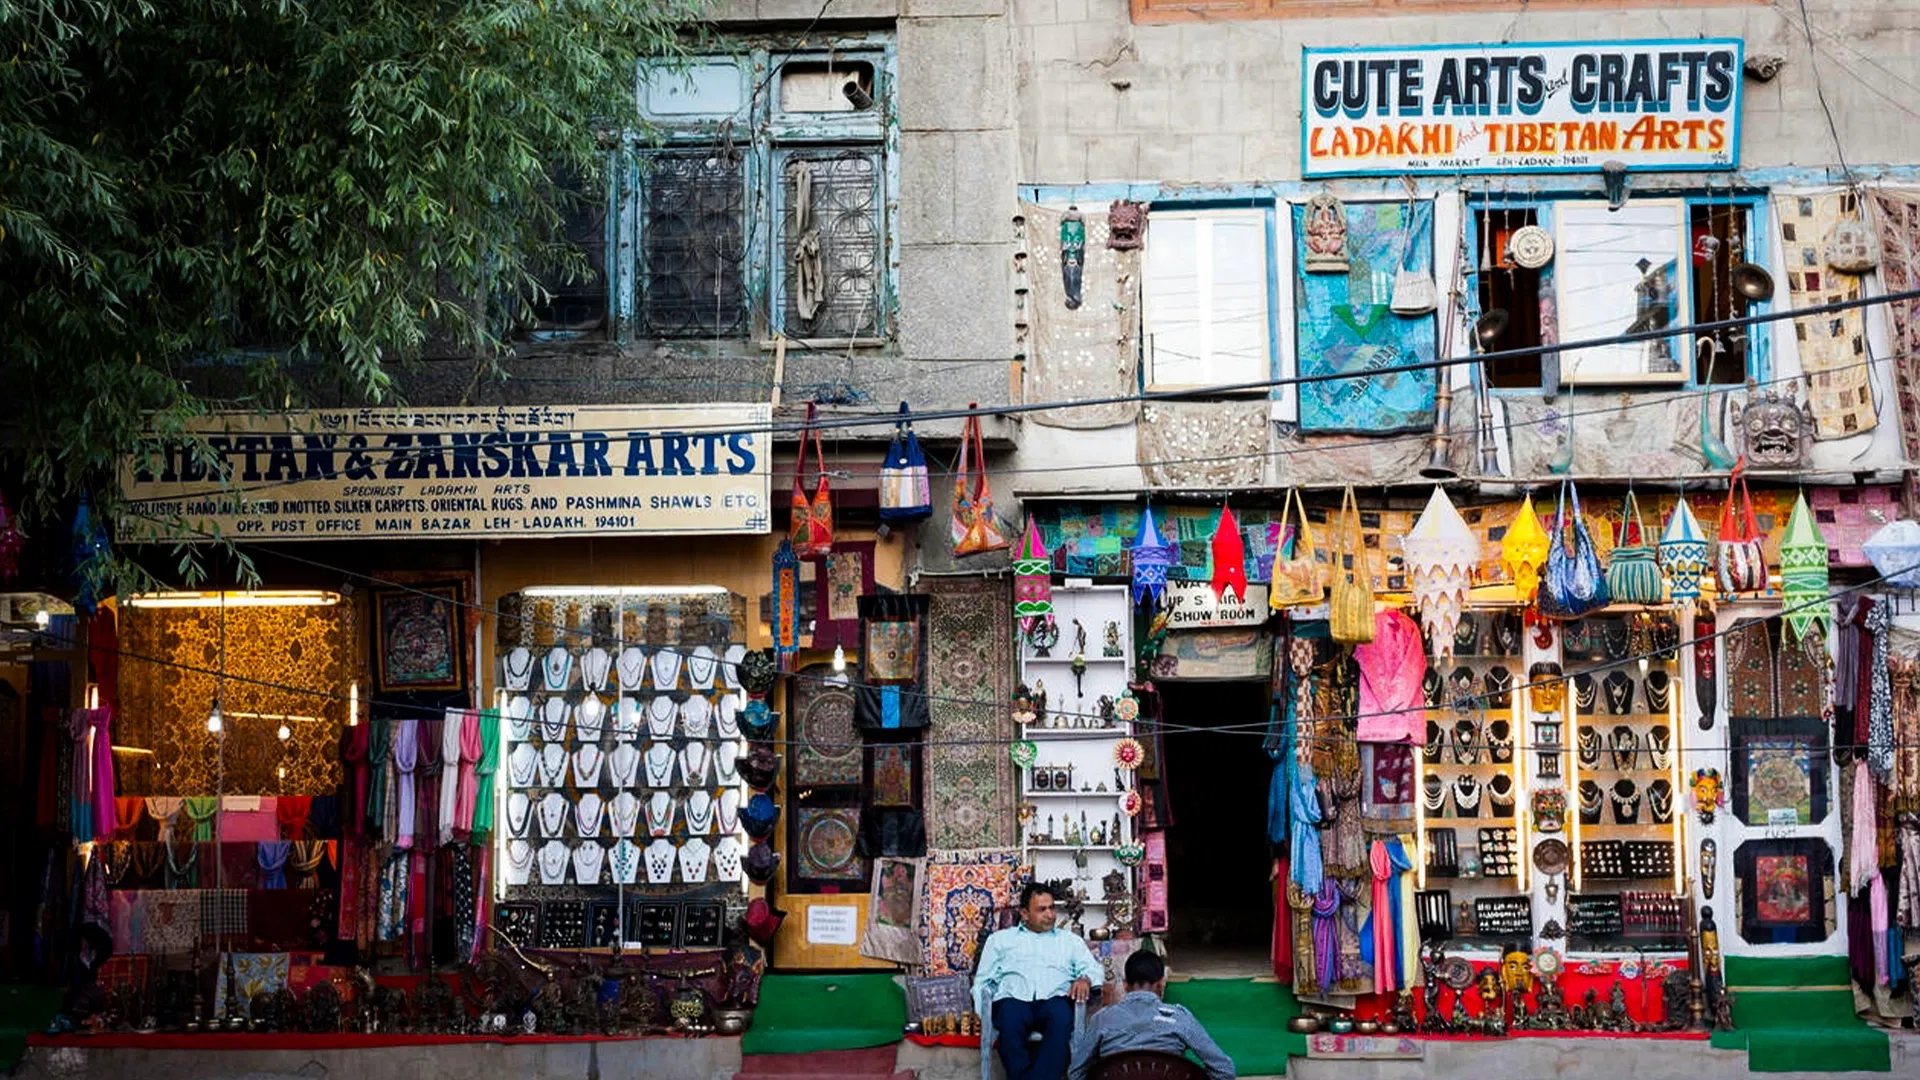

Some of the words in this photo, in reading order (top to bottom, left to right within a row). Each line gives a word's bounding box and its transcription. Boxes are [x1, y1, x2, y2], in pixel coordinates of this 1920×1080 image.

[1314, 59, 1423, 118] CUTE
[1433, 55, 1546, 115] ARTS
[1570, 51, 1734, 114] CRAFTS
[1309, 121, 1453, 158] LADAKHI
[1484, 121, 1617, 153] TIBETAN
[1622, 115, 1726, 151] ARTS
[344, 434, 377, 480] &
[382, 432, 613, 480] ZANSKAR
[624, 431, 756, 477] ARTS
[420, 484, 477, 495] LADAKHI
[494, 483, 531, 494] ARTS
[128, 502, 183, 516] XCLUSIVE
[333, 500, 372, 513] SILKEN
[430, 498, 487, 512] ORIENTAL
[530, 497, 558, 510] AND
[565, 495, 642, 509] PASHMINA
[650, 495, 712, 508] SHAWLS
[236, 520, 265, 532] OPP.
[271, 520, 306, 532] POST
[316, 519, 361, 531] OFFICE
[375, 518, 412, 531] MAIN
[422, 517, 471, 530] BAZAR
[595, 515, 635, 528] 194101
[1168, 595, 1184, 606] UP
[1174, 610, 1213, 622] SHOW
[1220, 609, 1255, 620] ROOM
